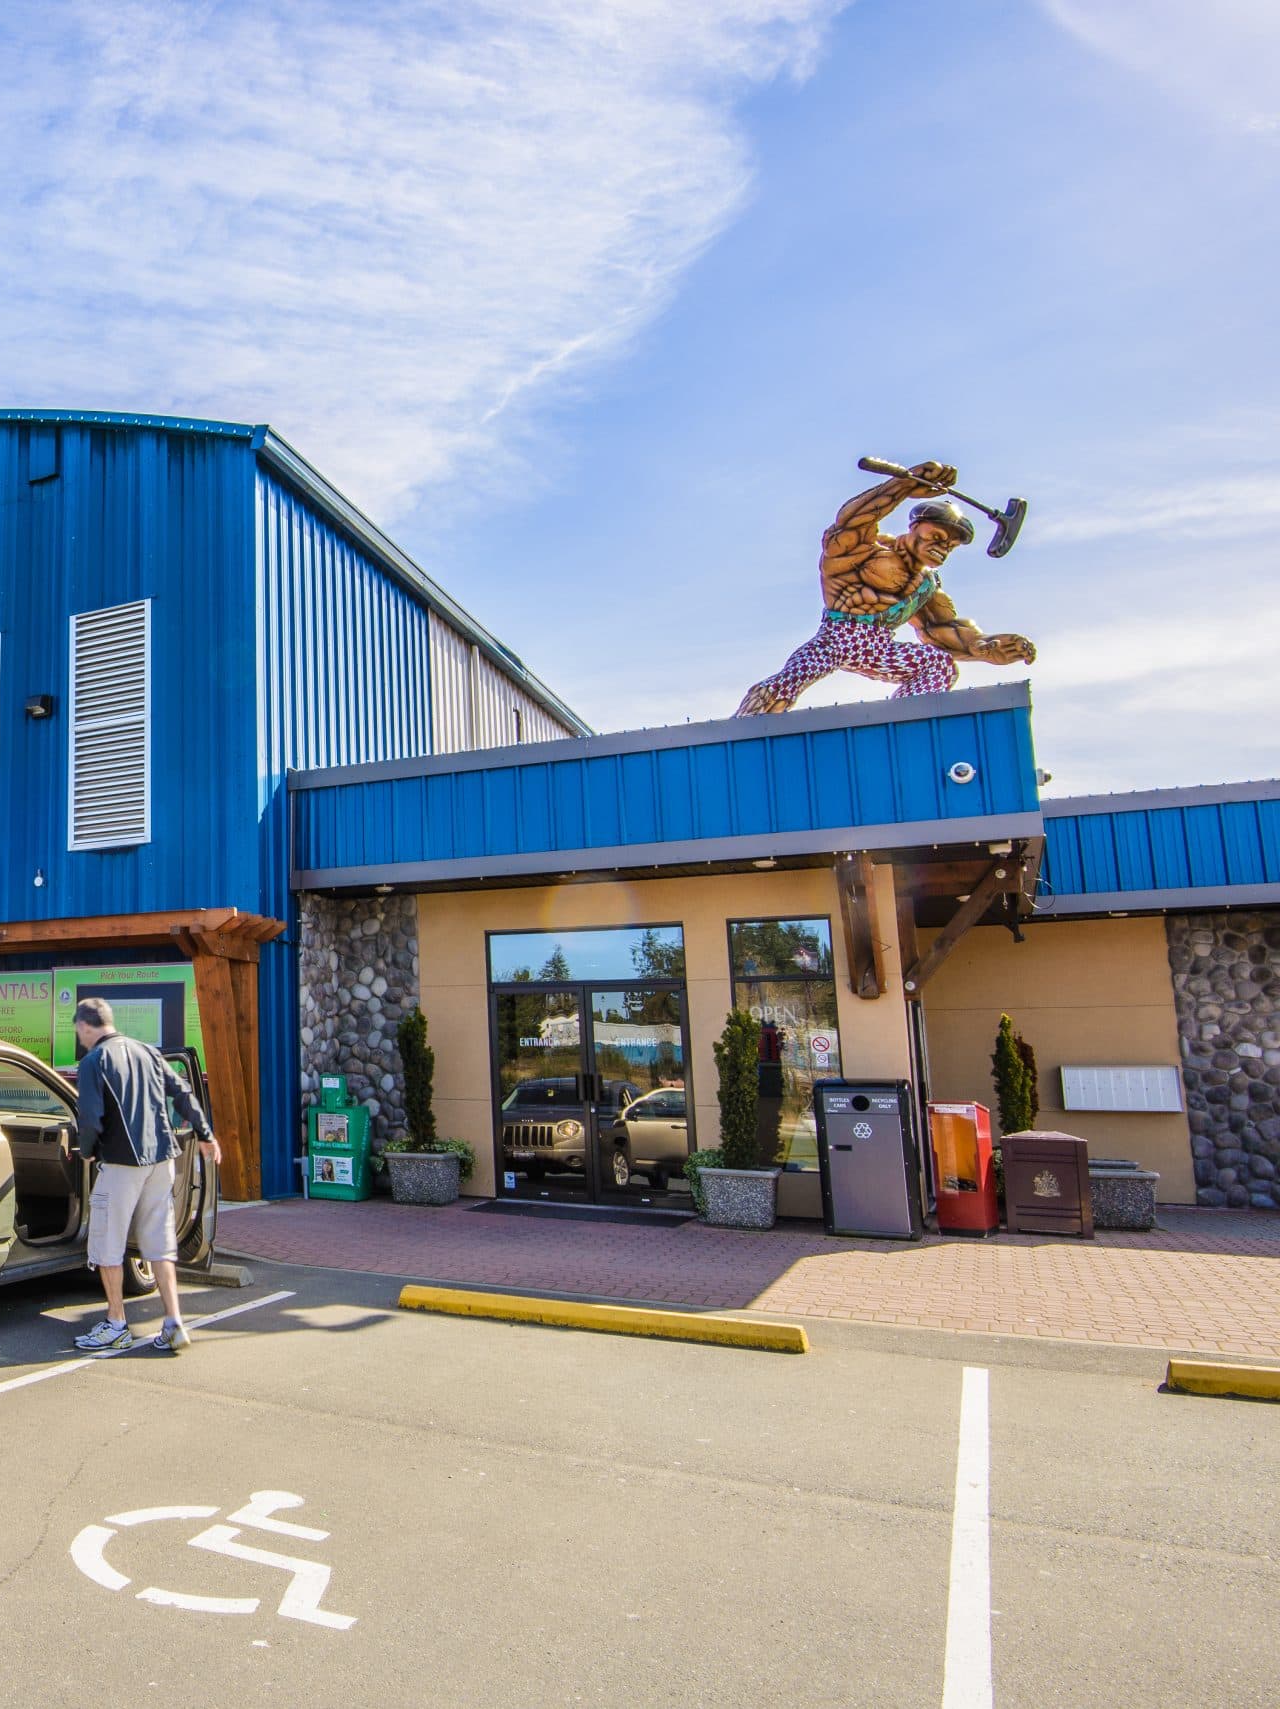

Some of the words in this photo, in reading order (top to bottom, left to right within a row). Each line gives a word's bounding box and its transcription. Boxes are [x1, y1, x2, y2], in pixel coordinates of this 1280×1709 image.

[100, 971, 115, 980] Pick
[136, 970, 160, 979] Route
[749, 1006, 800, 1025] OPEN
[519, 1037, 561, 1047] ENTRANCE
[616, 1037, 657, 1047] ENTRANCE
